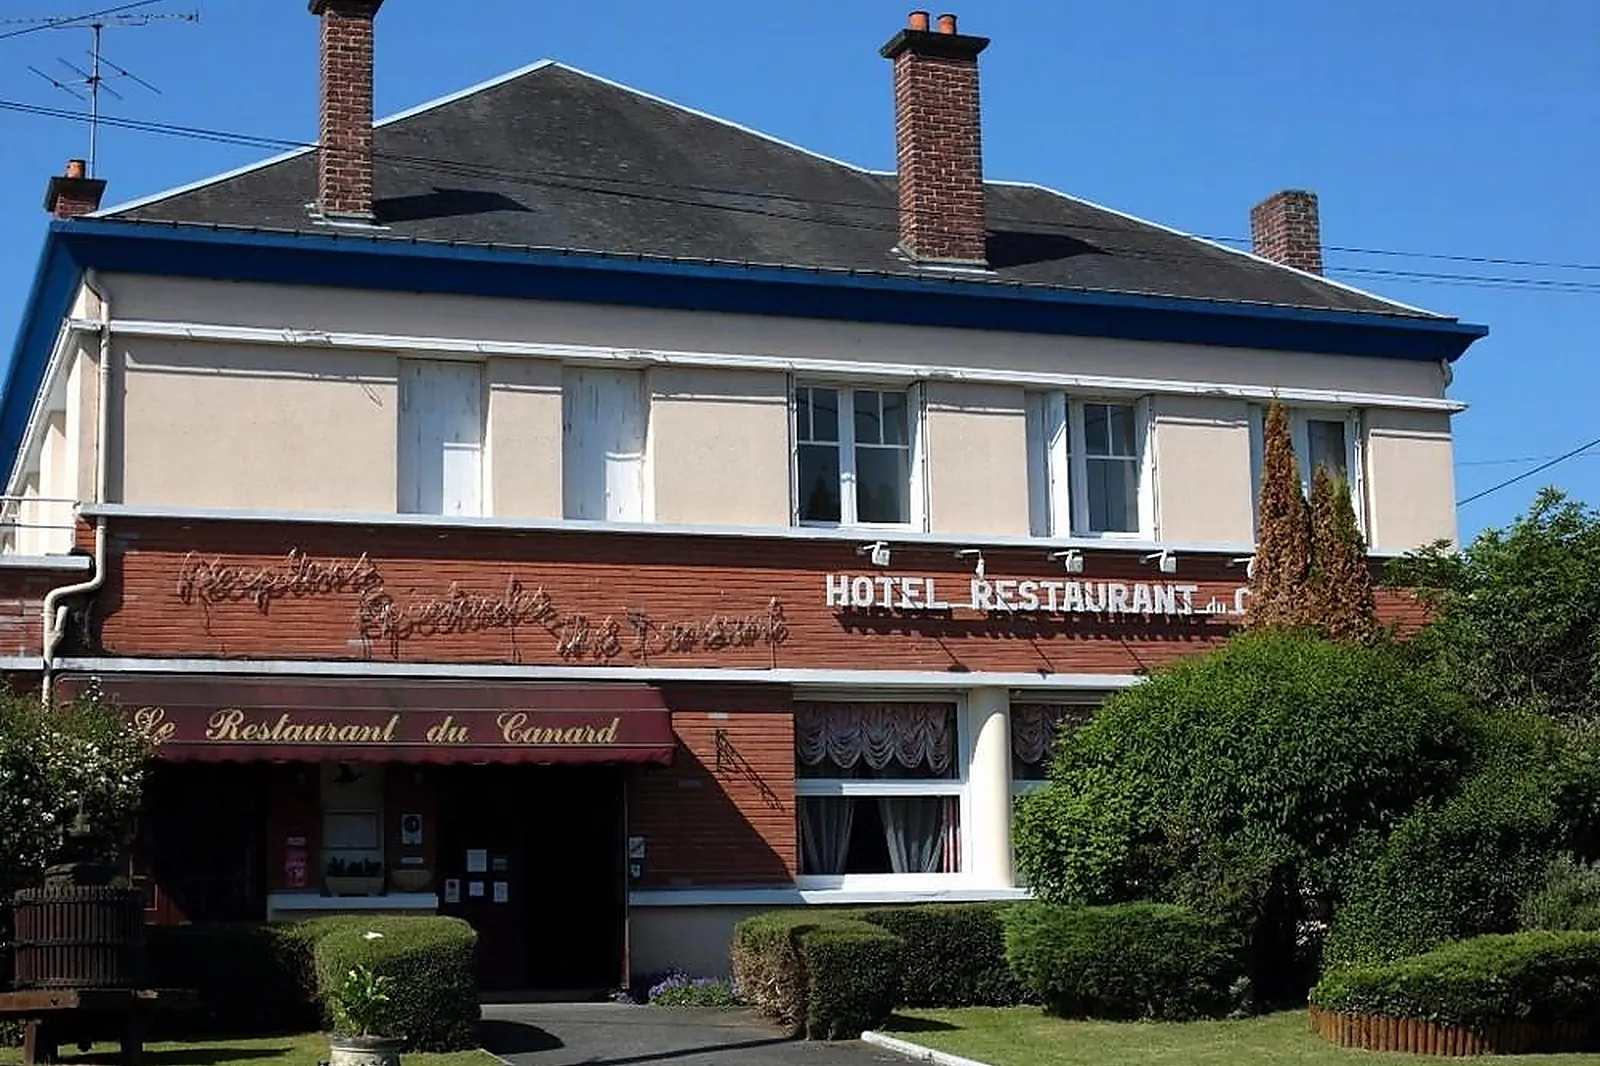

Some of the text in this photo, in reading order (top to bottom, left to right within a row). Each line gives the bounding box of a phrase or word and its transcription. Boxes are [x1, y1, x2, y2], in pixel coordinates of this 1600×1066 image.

[825, 573, 948, 611] HOTEL
[970, 577, 1197, 615] RESTAURANT
[1206, 595, 1226, 614] du
[135, 706, 622, 744] Le Restaurant du Canard
